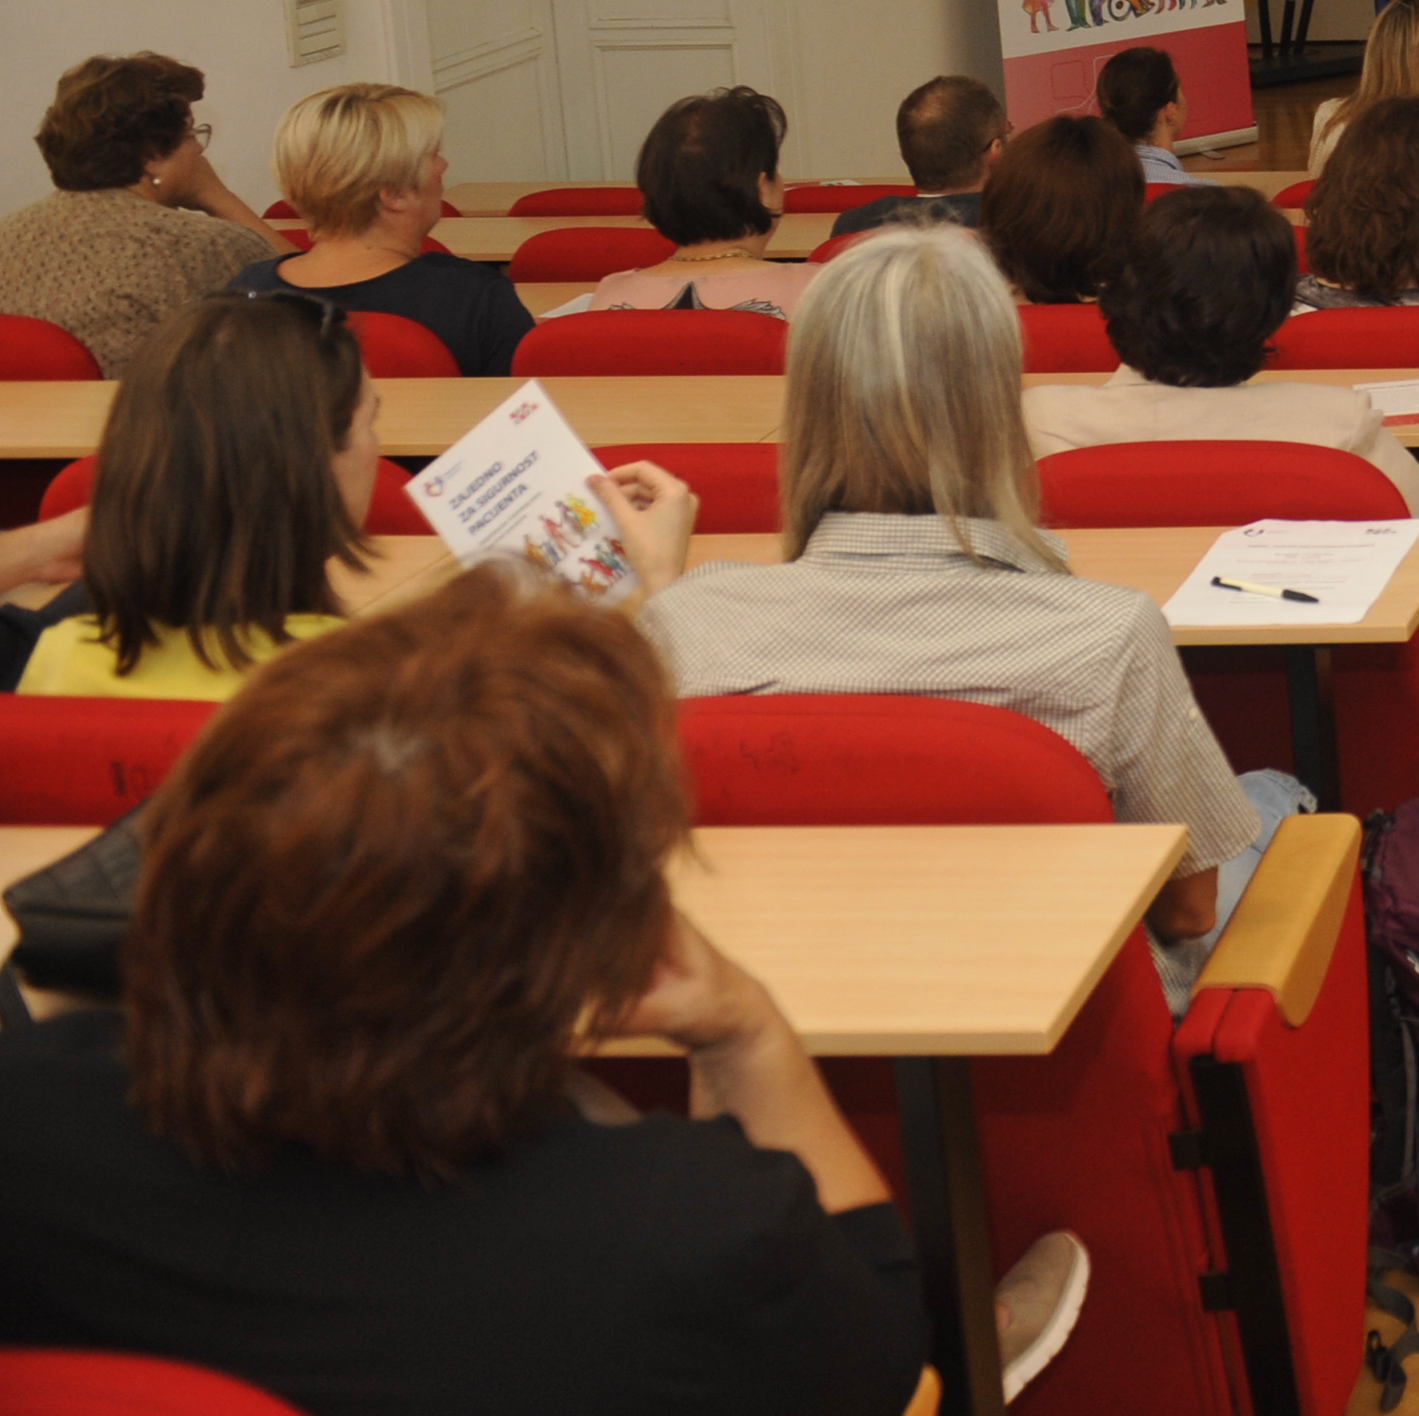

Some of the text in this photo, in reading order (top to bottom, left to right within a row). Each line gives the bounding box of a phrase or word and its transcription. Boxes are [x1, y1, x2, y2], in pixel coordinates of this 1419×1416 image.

[449, 461, 502, 510] ZAJEDNO
[458, 506, 477, 523] ZA
[476, 450, 538, 508] SIGURNOST
[468, 483, 528, 535] PACIJENTA
